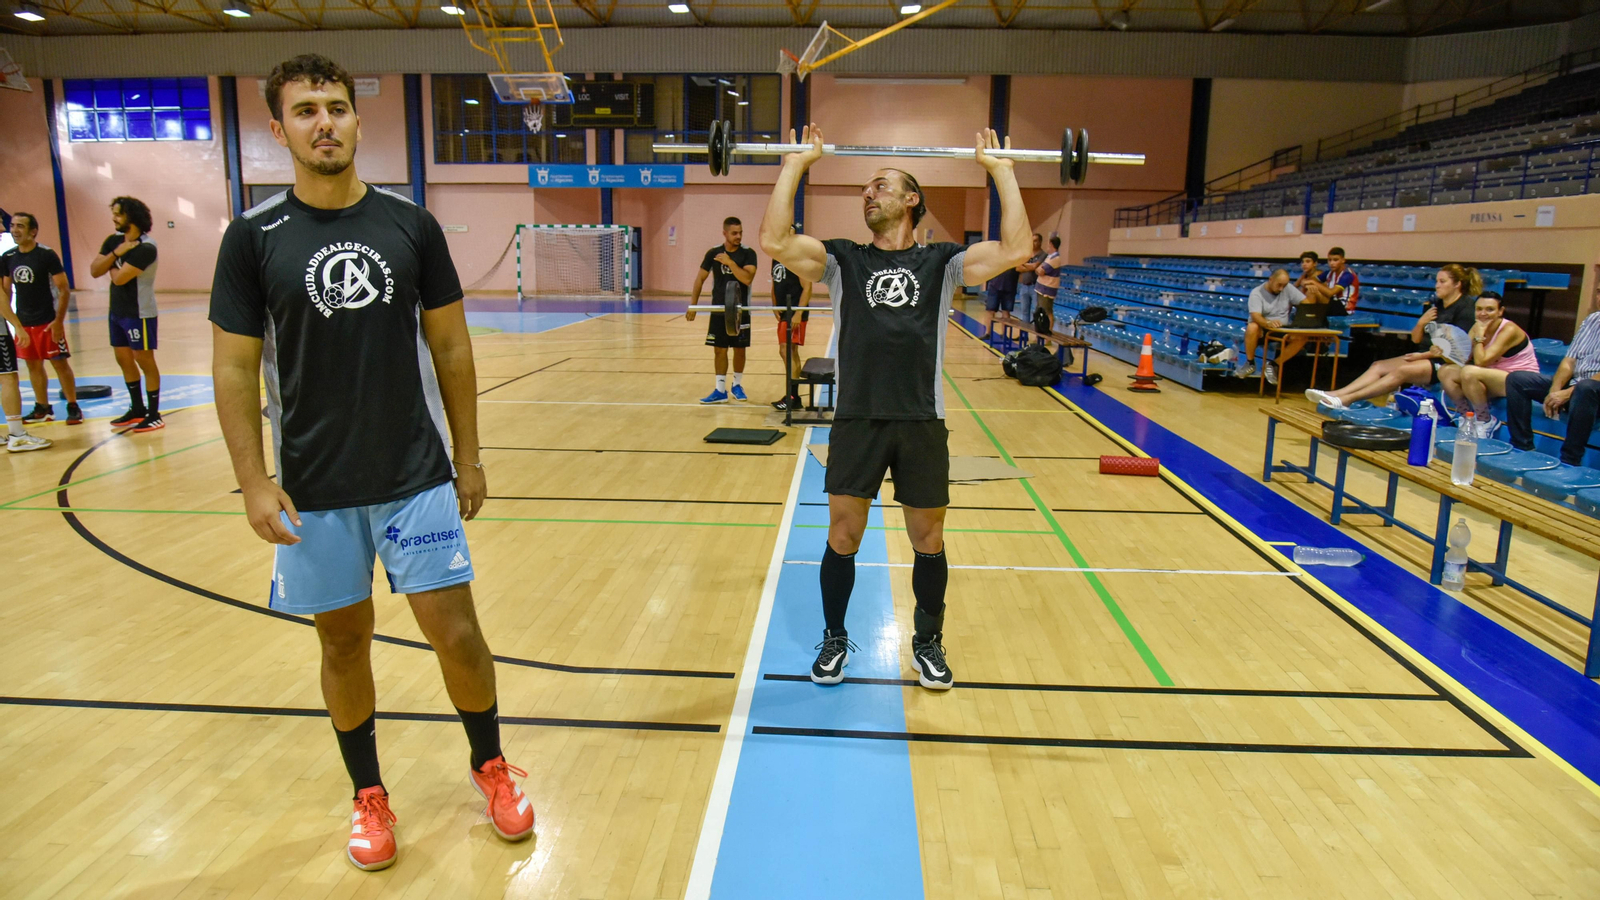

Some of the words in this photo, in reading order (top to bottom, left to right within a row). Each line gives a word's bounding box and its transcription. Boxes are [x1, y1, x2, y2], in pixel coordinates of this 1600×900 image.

[1470, 213, 1502, 223] PRENSA
[305, 241, 394, 318] BMCIUDADDEALGECIRAS.COM
[127, 328, 141, 339] 18
[400, 528, 459, 551] practiser
